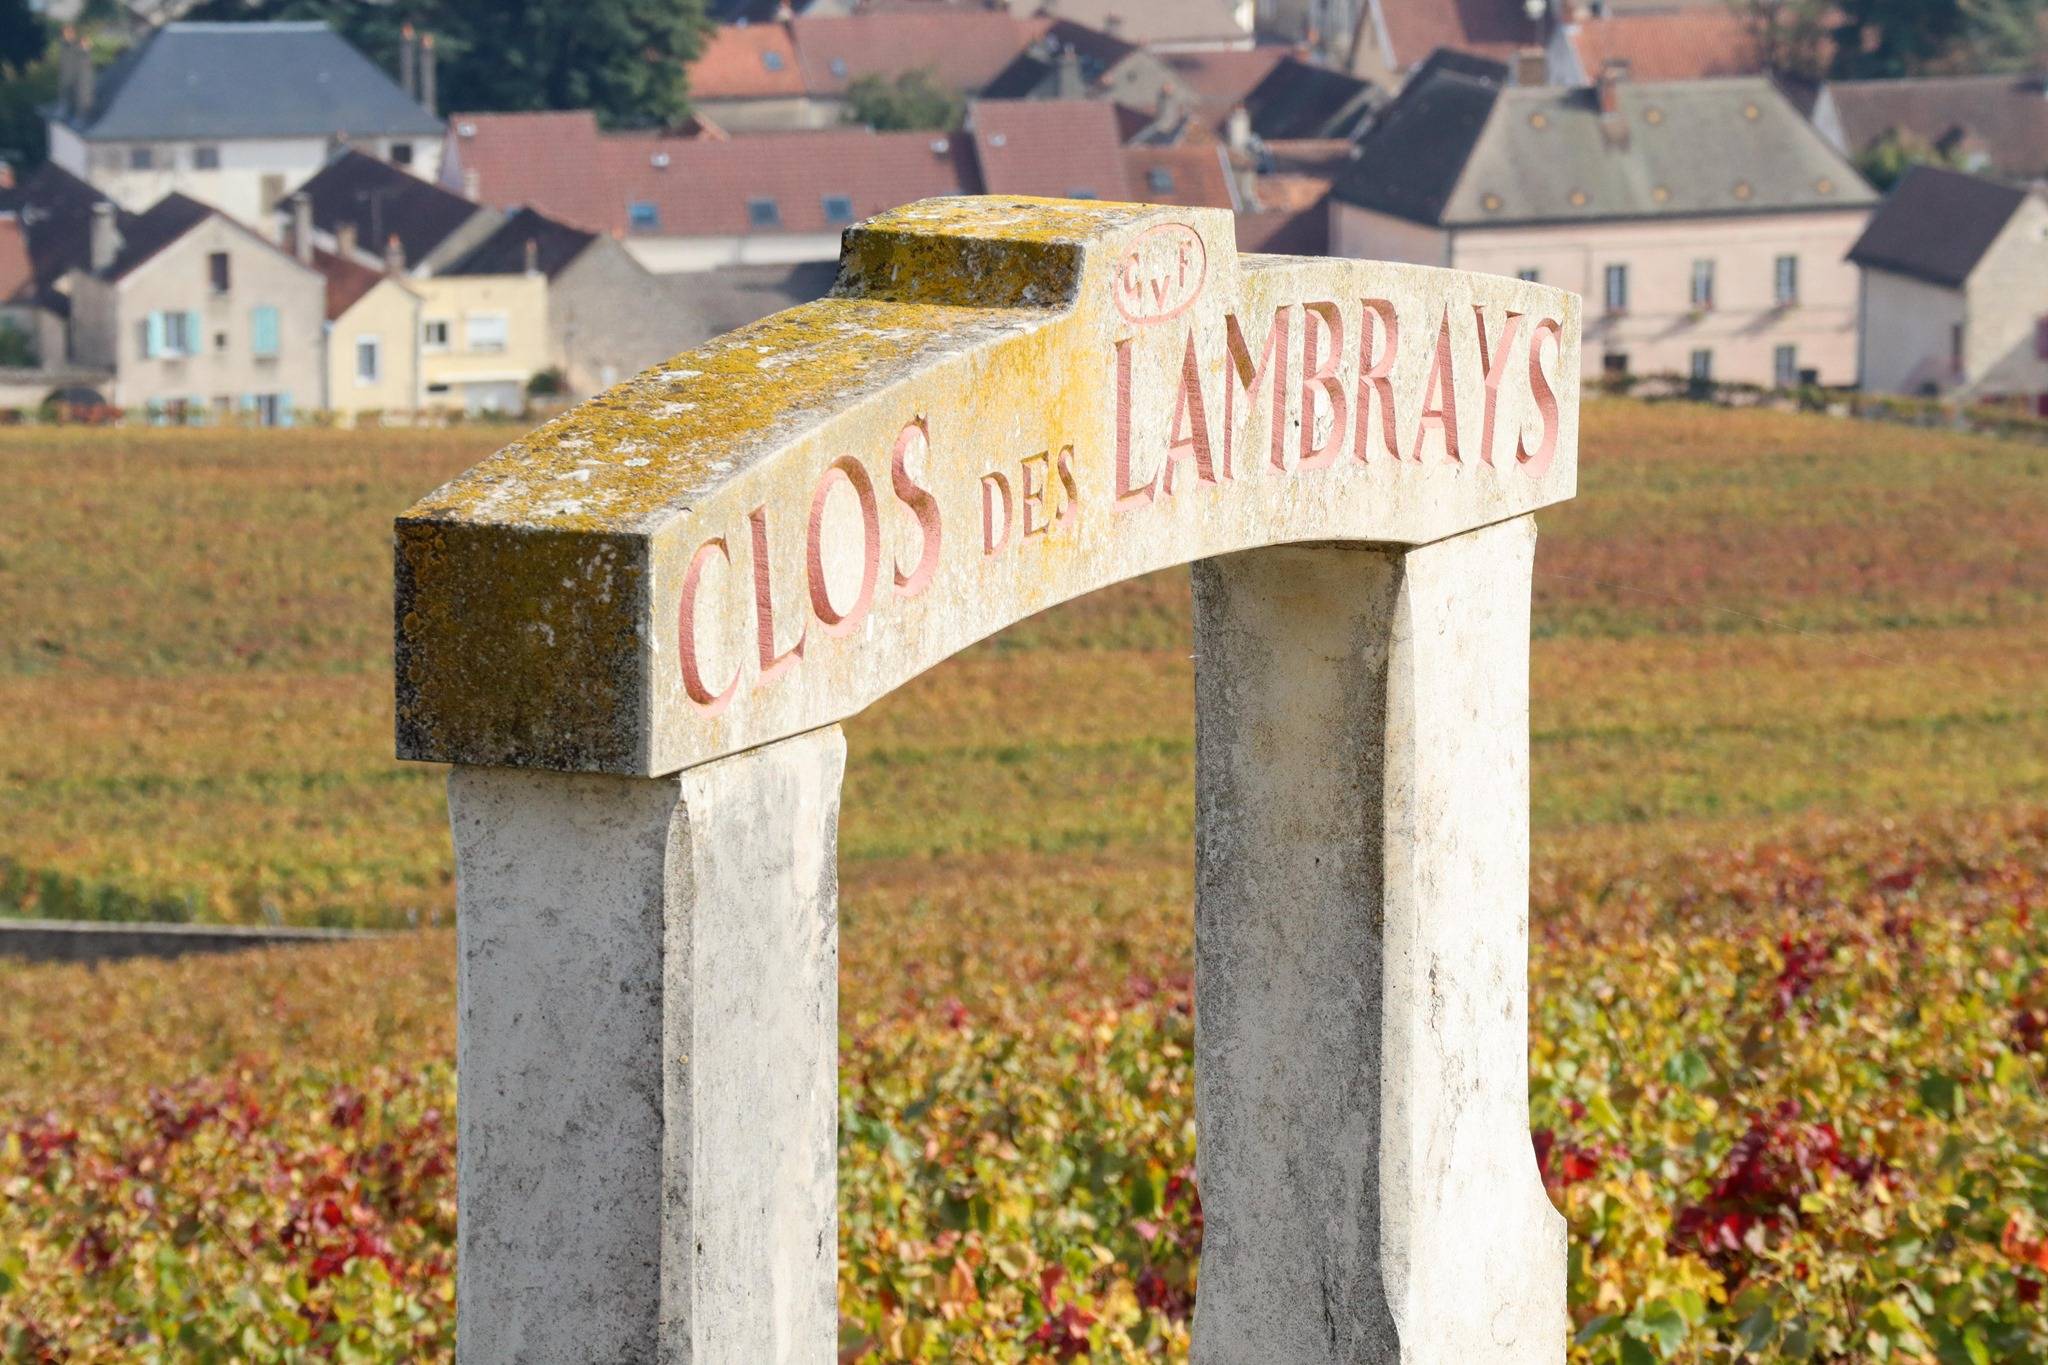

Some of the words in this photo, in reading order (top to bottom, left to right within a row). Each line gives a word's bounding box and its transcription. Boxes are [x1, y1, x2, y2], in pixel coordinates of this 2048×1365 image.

[677, 413, 942, 719] CLOS
[979, 444, 1078, 561] DES
[1113, 298, 1564, 513] LAMBRAYS
